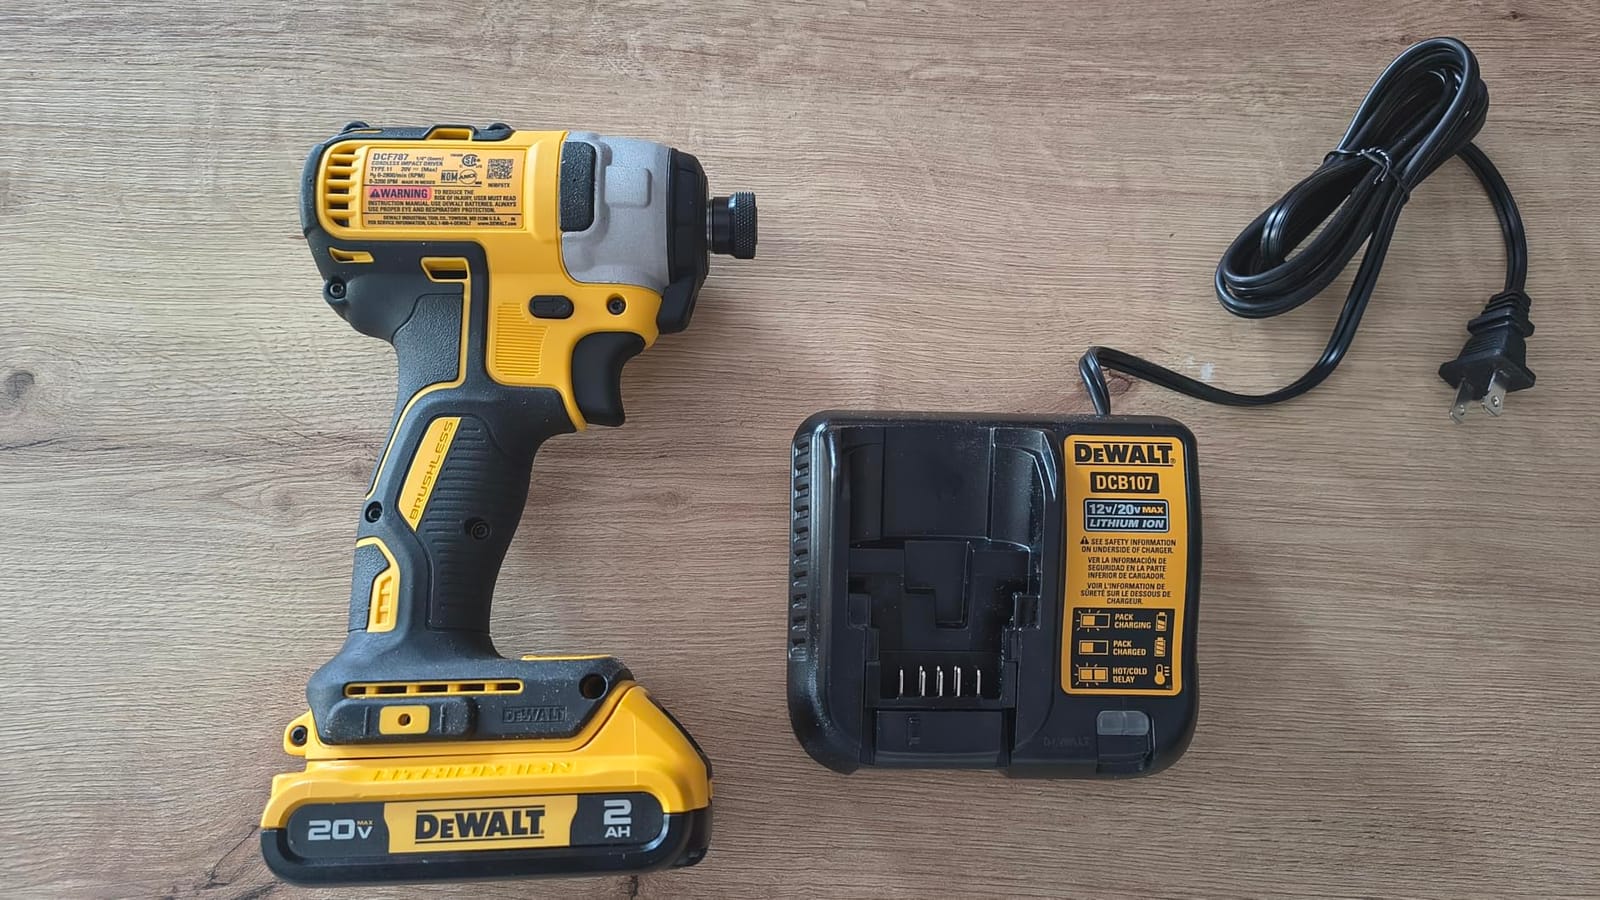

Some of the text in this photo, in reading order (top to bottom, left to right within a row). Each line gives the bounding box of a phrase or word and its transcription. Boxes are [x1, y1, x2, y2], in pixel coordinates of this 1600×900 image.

[441, 172, 458, 181] NOM
[381, 189, 428, 198] WARNING
[409, 421, 453, 520] BRUSHLESS
[1095, 475, 1153, 490] DCB107
[1142, 506, 1164, 514] MAX
[1089, 519, 1164, 529] LITHIUM ION
[1130, 539, 1176, 547] INFORMATION
[1111, 556, 1157, 564] INFORMACIÓN
[1113, 648, 1147, 656] CHARGED
[603, 799, 632, 825] 2
[604, 826, 631, 838] AH
